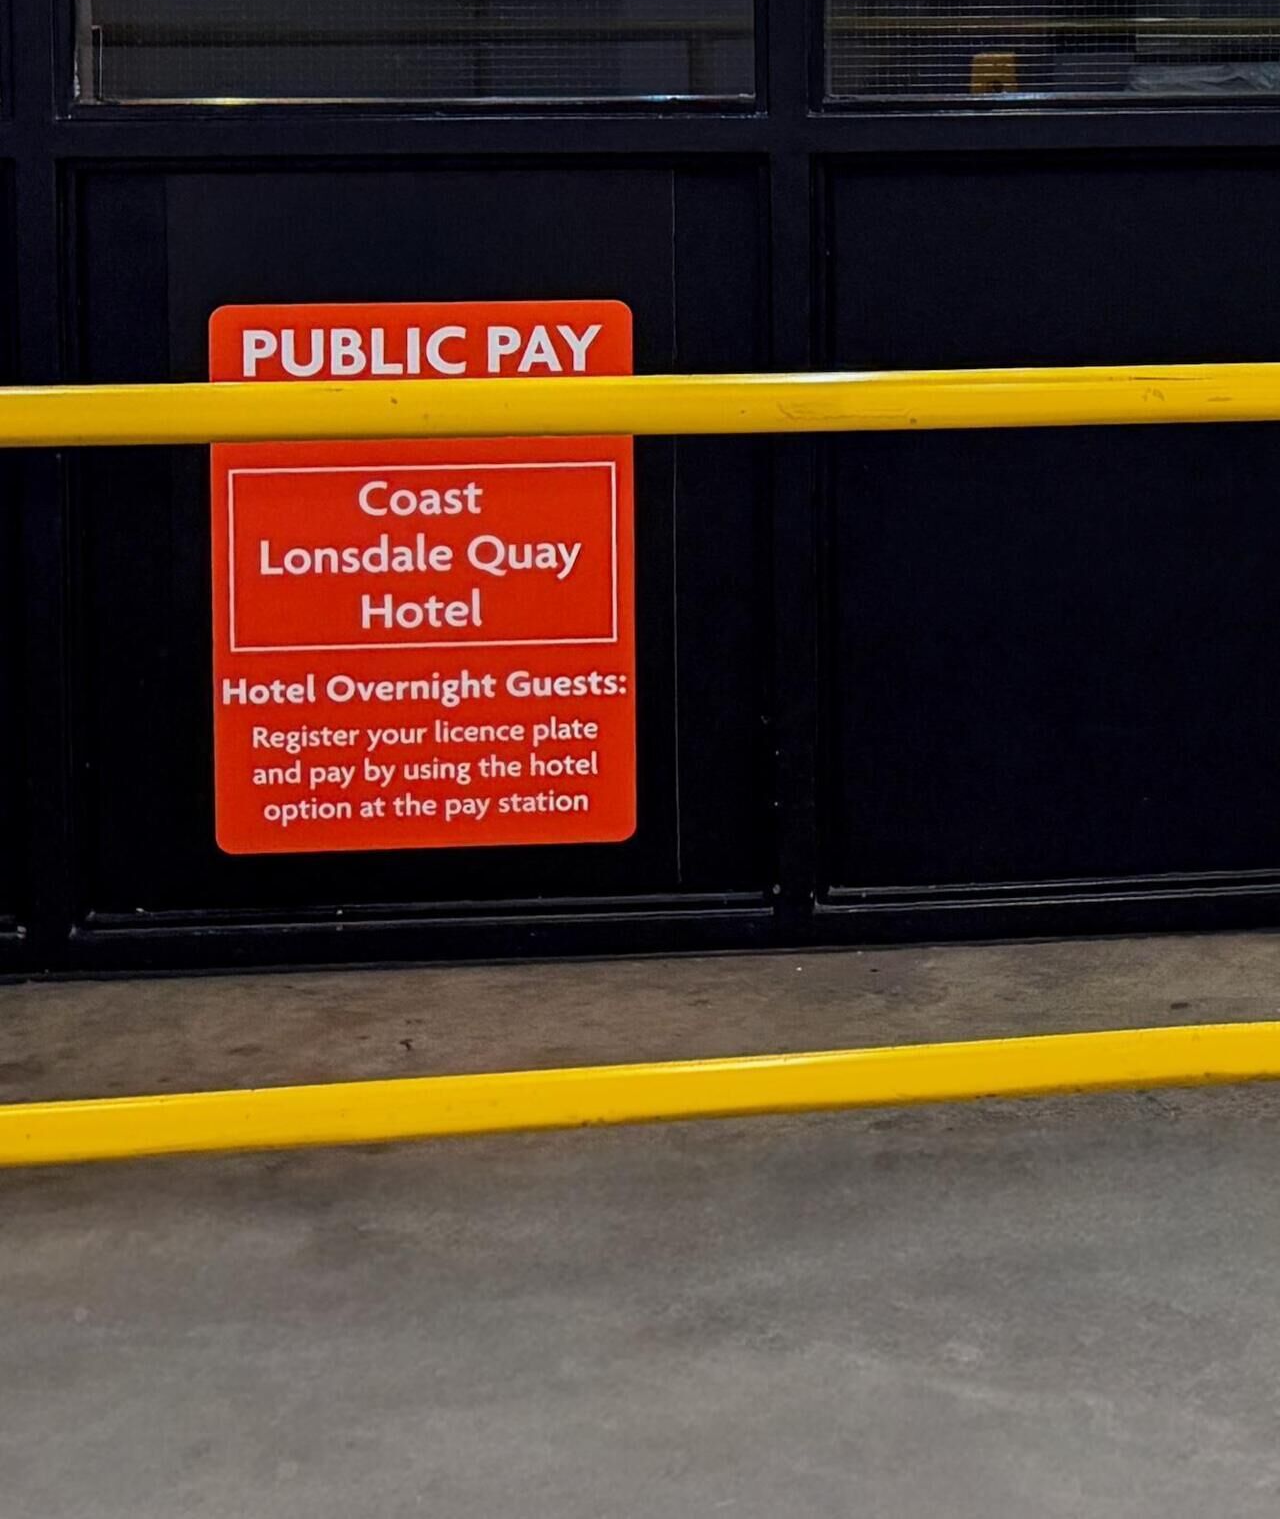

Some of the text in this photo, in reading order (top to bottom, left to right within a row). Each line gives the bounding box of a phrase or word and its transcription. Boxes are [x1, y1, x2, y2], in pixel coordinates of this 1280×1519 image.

[242, 325, 603, 377] PUBLIC PAY
[359, 481, 482, 516] Coast
[261, 533, 581, 579] Lonsdale Quay
[362, 588, 482, 628] Hotel
[223, 670, 626, 707] Hotel Overnight Guests:
[253, 717, 598, 754] Register your licence plate
[253, 751, 597, 789] and pay by using the hotel
[264, 790, 588, 826] option at the pay station
